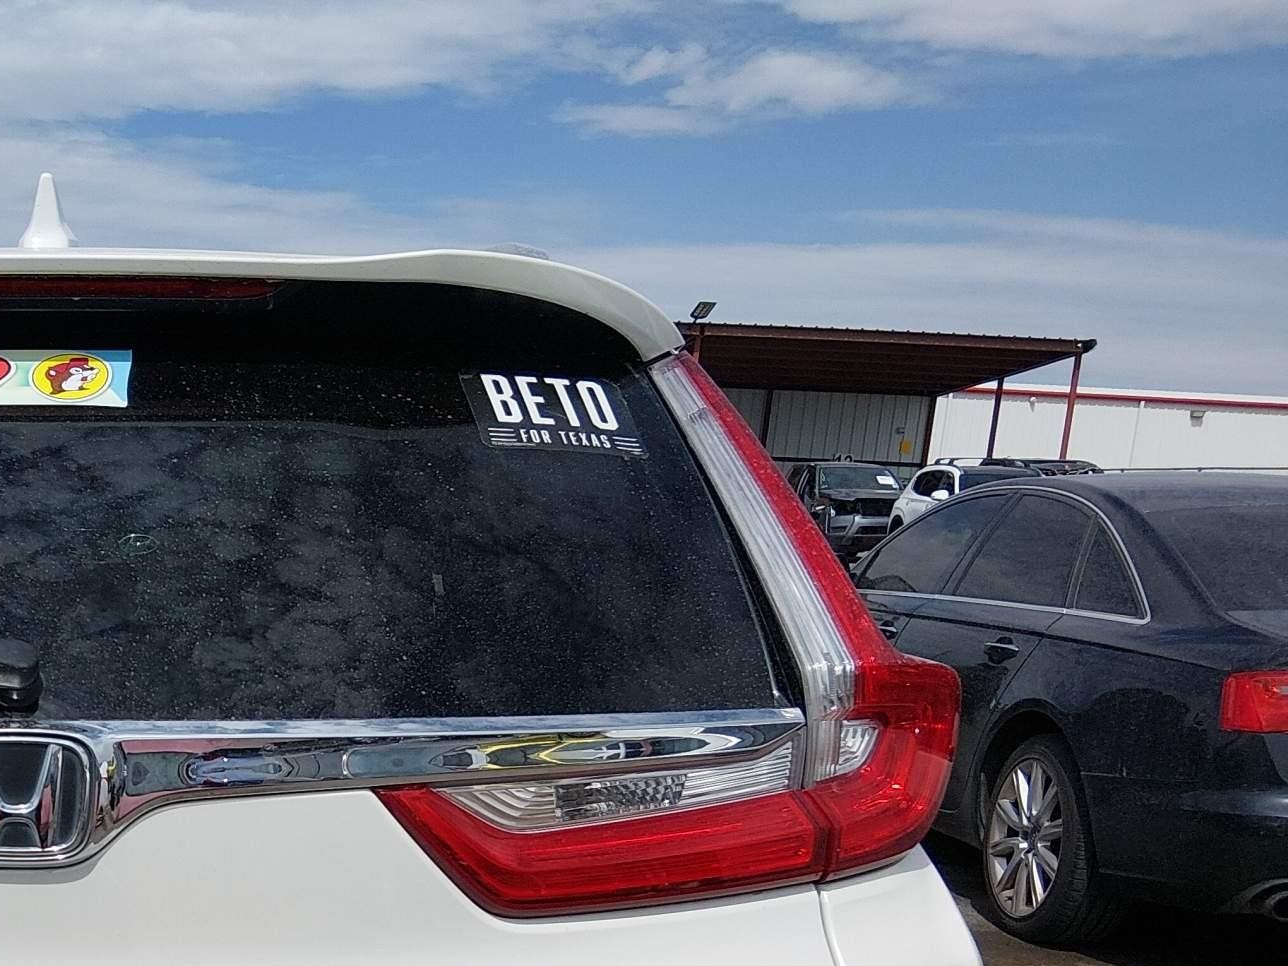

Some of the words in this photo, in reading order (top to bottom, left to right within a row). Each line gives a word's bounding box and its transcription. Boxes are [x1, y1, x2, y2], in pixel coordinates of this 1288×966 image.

[480, 374, 619, 430] BETO
[519, 428, 552, 444] FOR
[558, 430, 612, 449] TEXAS
